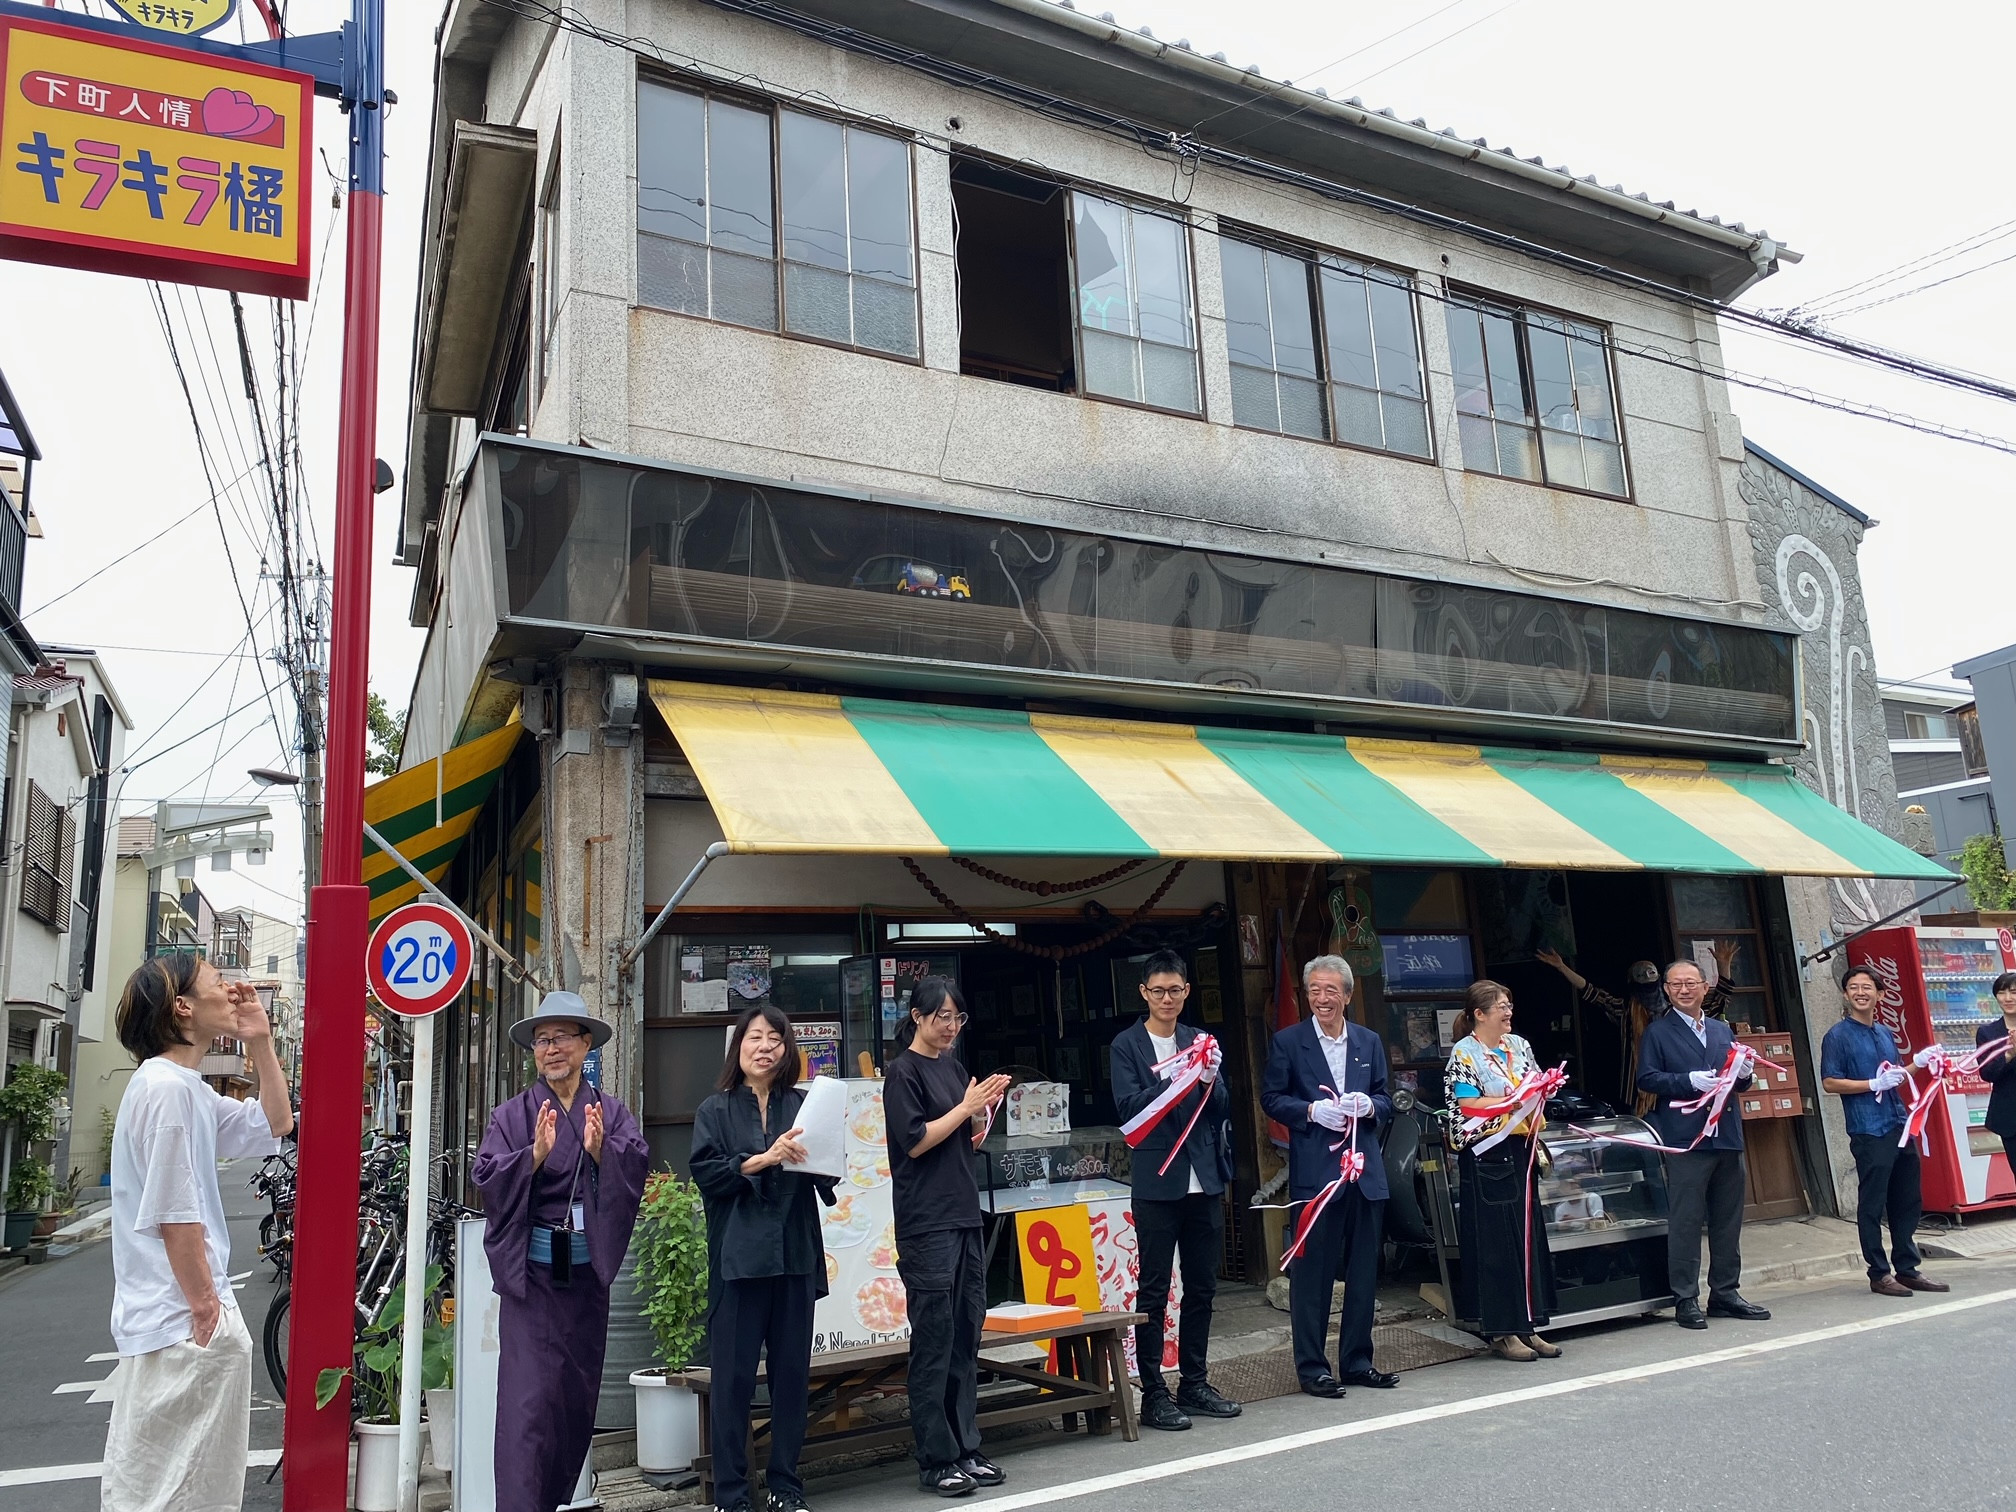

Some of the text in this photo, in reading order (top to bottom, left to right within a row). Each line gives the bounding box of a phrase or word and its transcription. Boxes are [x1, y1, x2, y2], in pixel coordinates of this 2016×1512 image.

[137, 2, 194, 29] キラキラ
[35, 76, 192, 128] 下町人情
[16, 131, 284, 238] キラキラ橘
